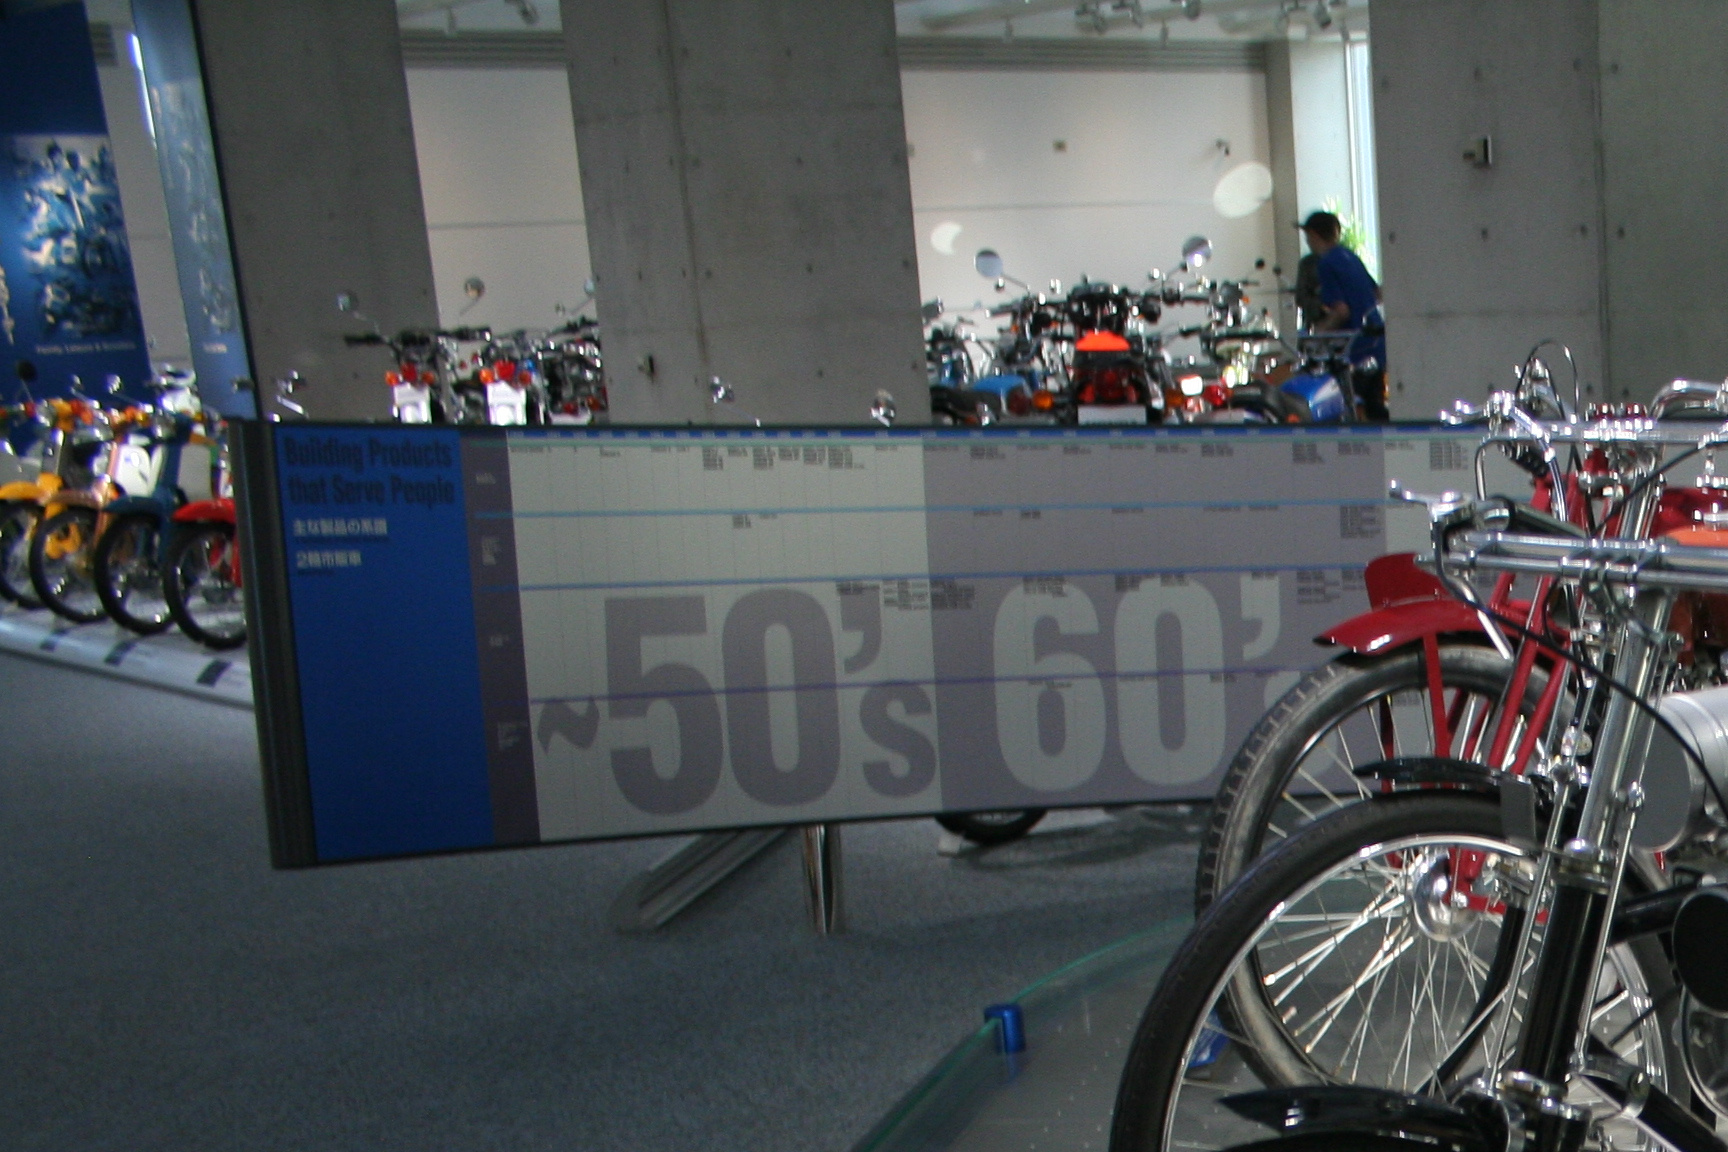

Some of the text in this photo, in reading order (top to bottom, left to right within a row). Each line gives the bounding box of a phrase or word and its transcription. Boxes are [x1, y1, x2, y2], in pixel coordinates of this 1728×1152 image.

[284, 436, 452, 474] Building Products
[288, 475, 327, 504] that
[333, 474, 385, 504] Serve
[391, 474, 455, 509] People
